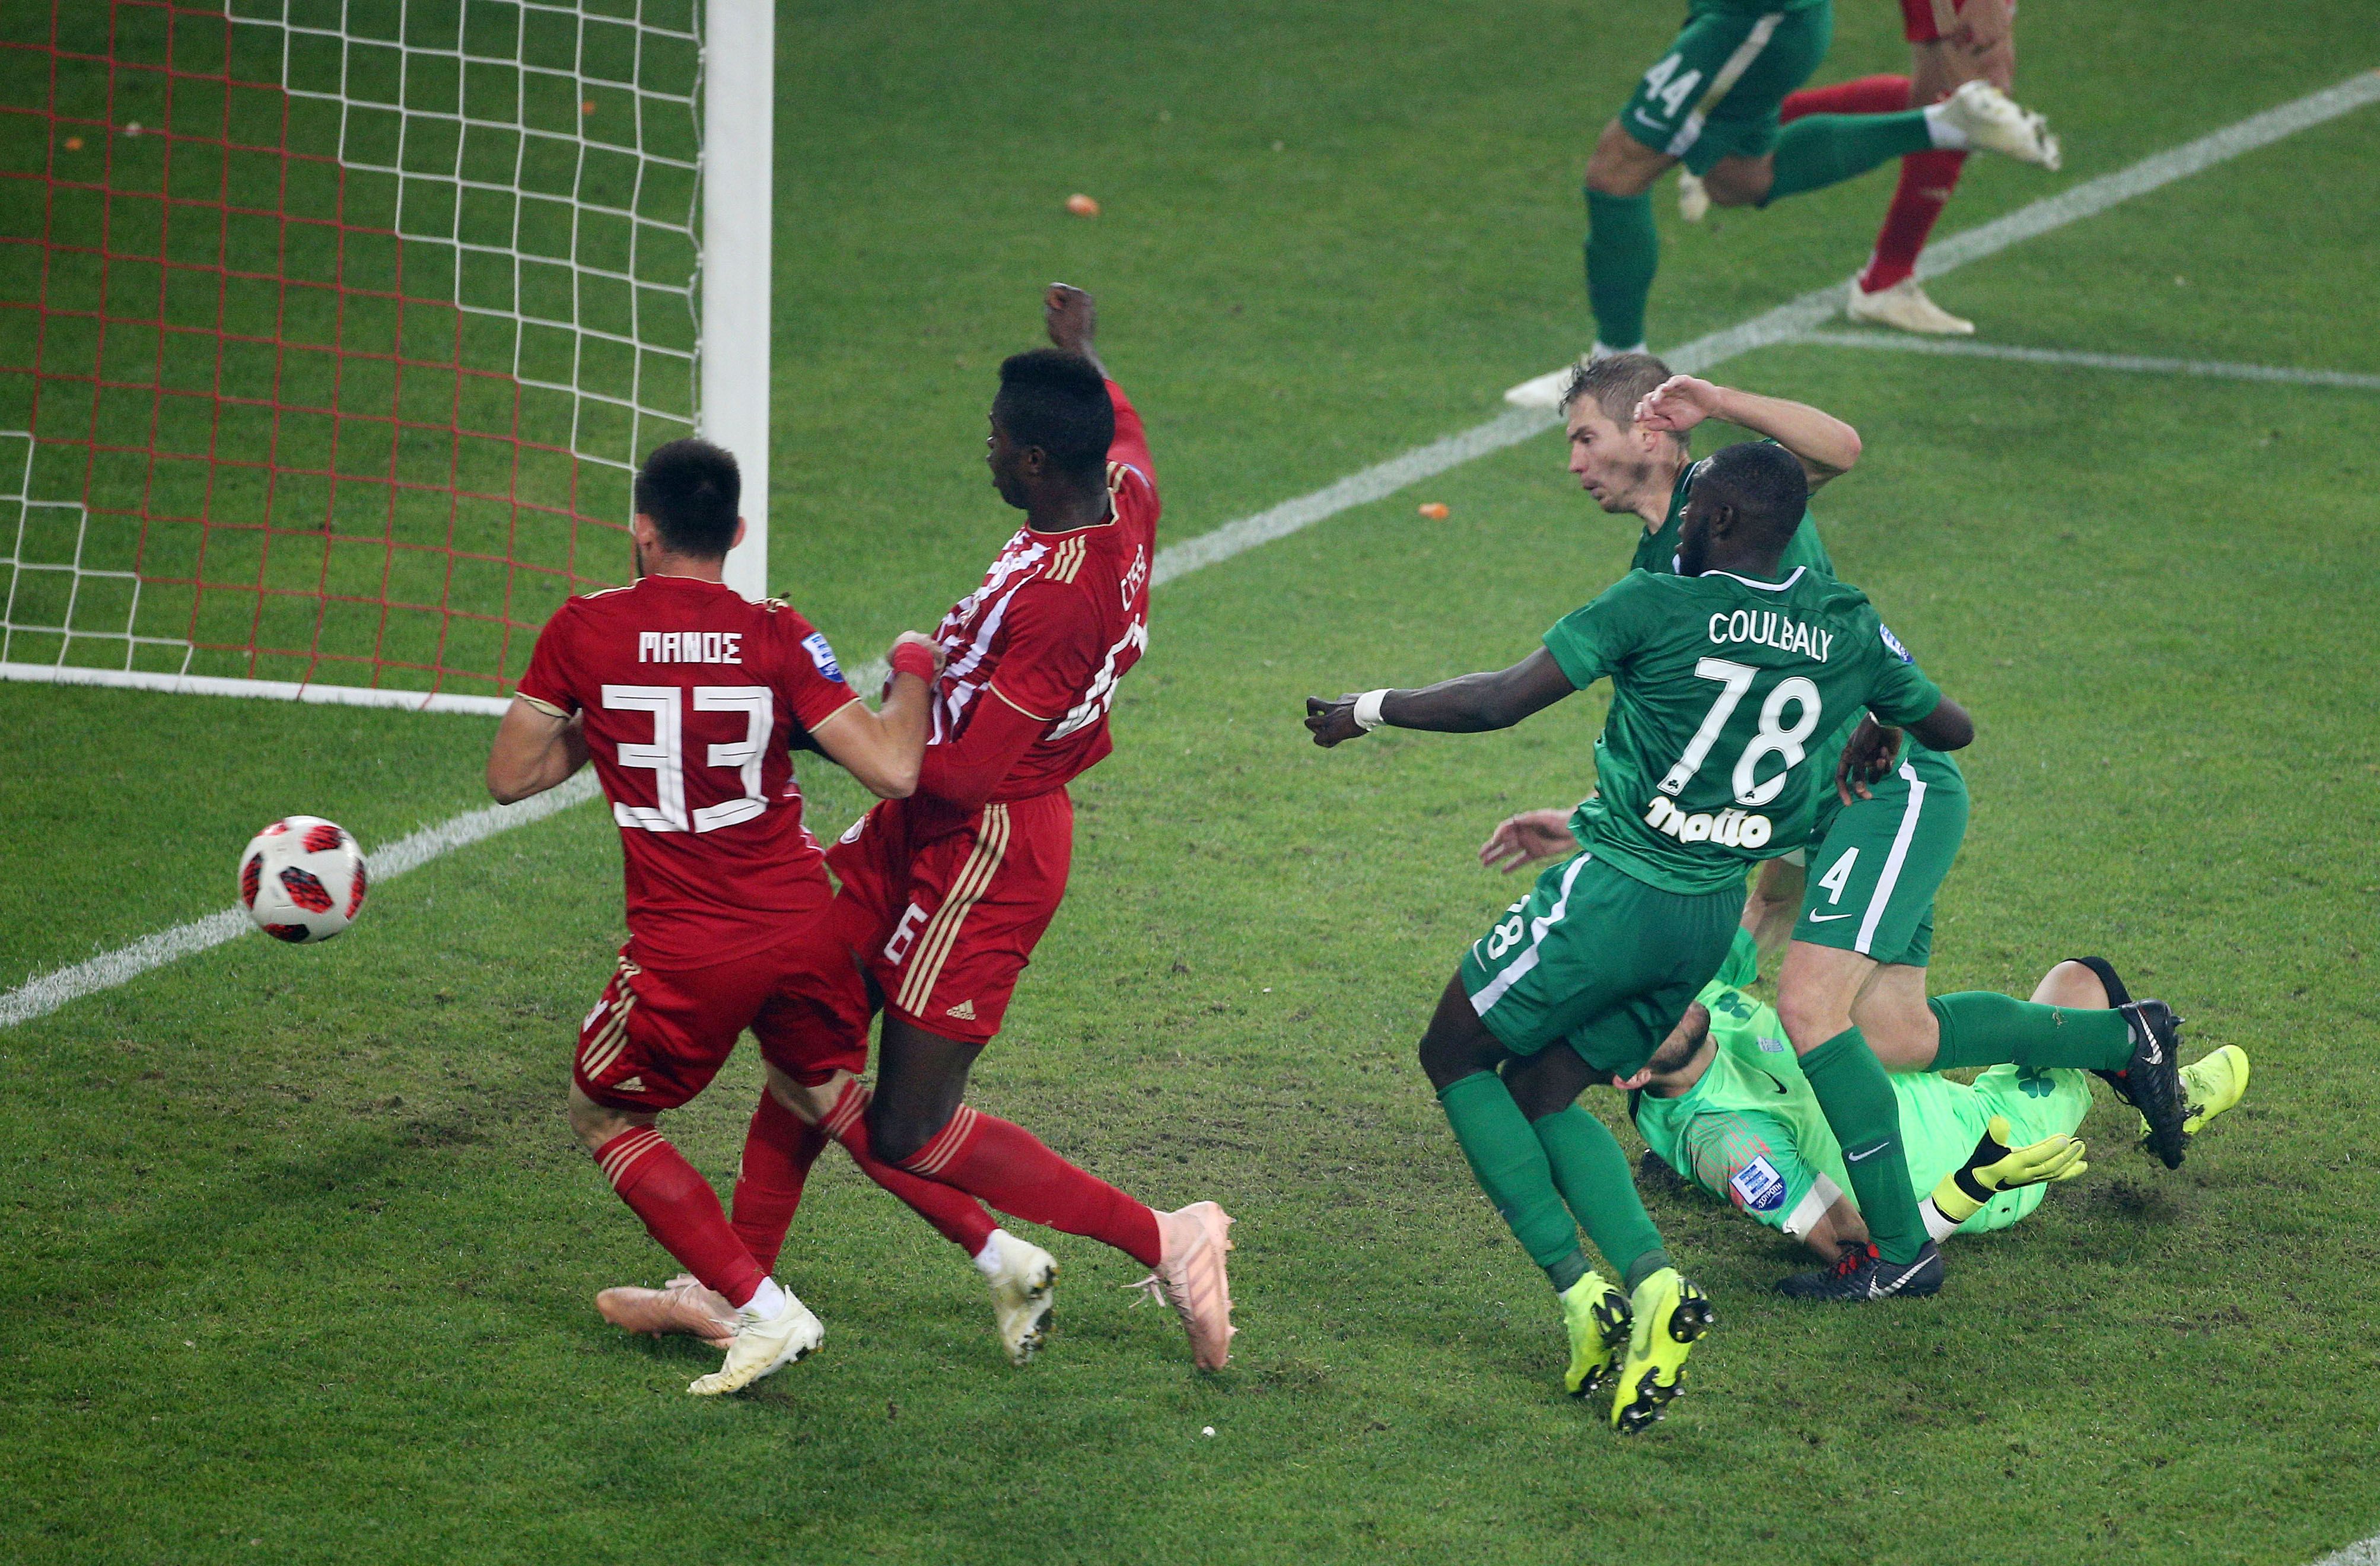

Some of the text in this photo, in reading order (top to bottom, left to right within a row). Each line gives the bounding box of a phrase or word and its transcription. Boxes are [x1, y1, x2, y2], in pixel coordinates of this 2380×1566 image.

[1646, 52, 1701, 118] 44
[601, 684, 774, 833] 33
[1656, 657, 1822, 806] 78
[1818, 846, 1860, 905] 4
